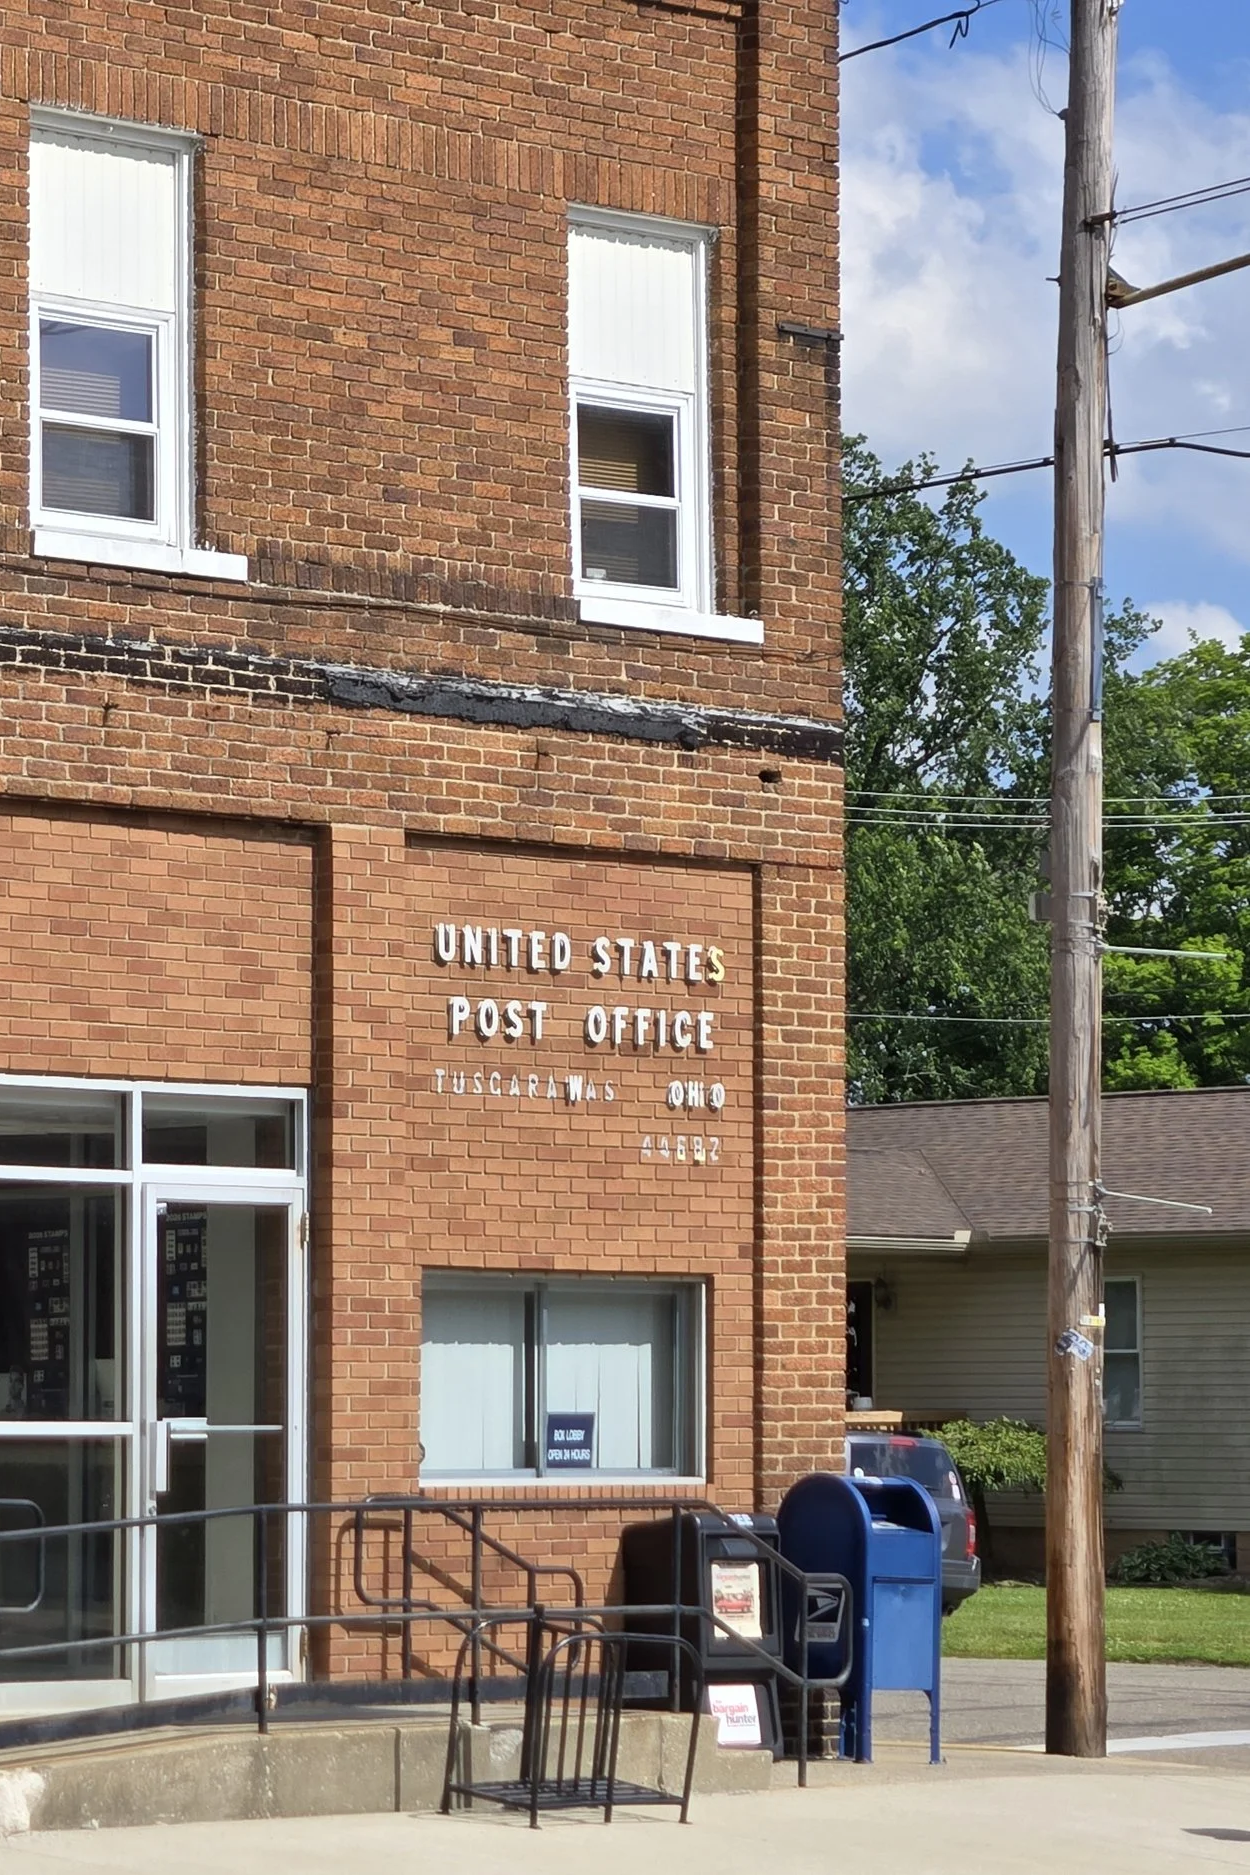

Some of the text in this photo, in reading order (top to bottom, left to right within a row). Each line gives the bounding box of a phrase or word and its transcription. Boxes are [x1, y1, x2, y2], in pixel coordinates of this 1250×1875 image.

[435, 923, 726, 982] UNITED STATES
[449, 996, 714, 1049] POST OFFICE
[435, 1068, 726, 1109] TUSCARAWAS OHIO
[641, 1135, 720, 1162] 44682
[554, 1429, 585, 1441] BOX LOBBY
[548, 1449, 562, 1460] OPEN
[570, 1449, 590, 1460] HOURS
[713, 1702, 749, 1716] bargain
[726, 1713, 757, 1725] hunter
